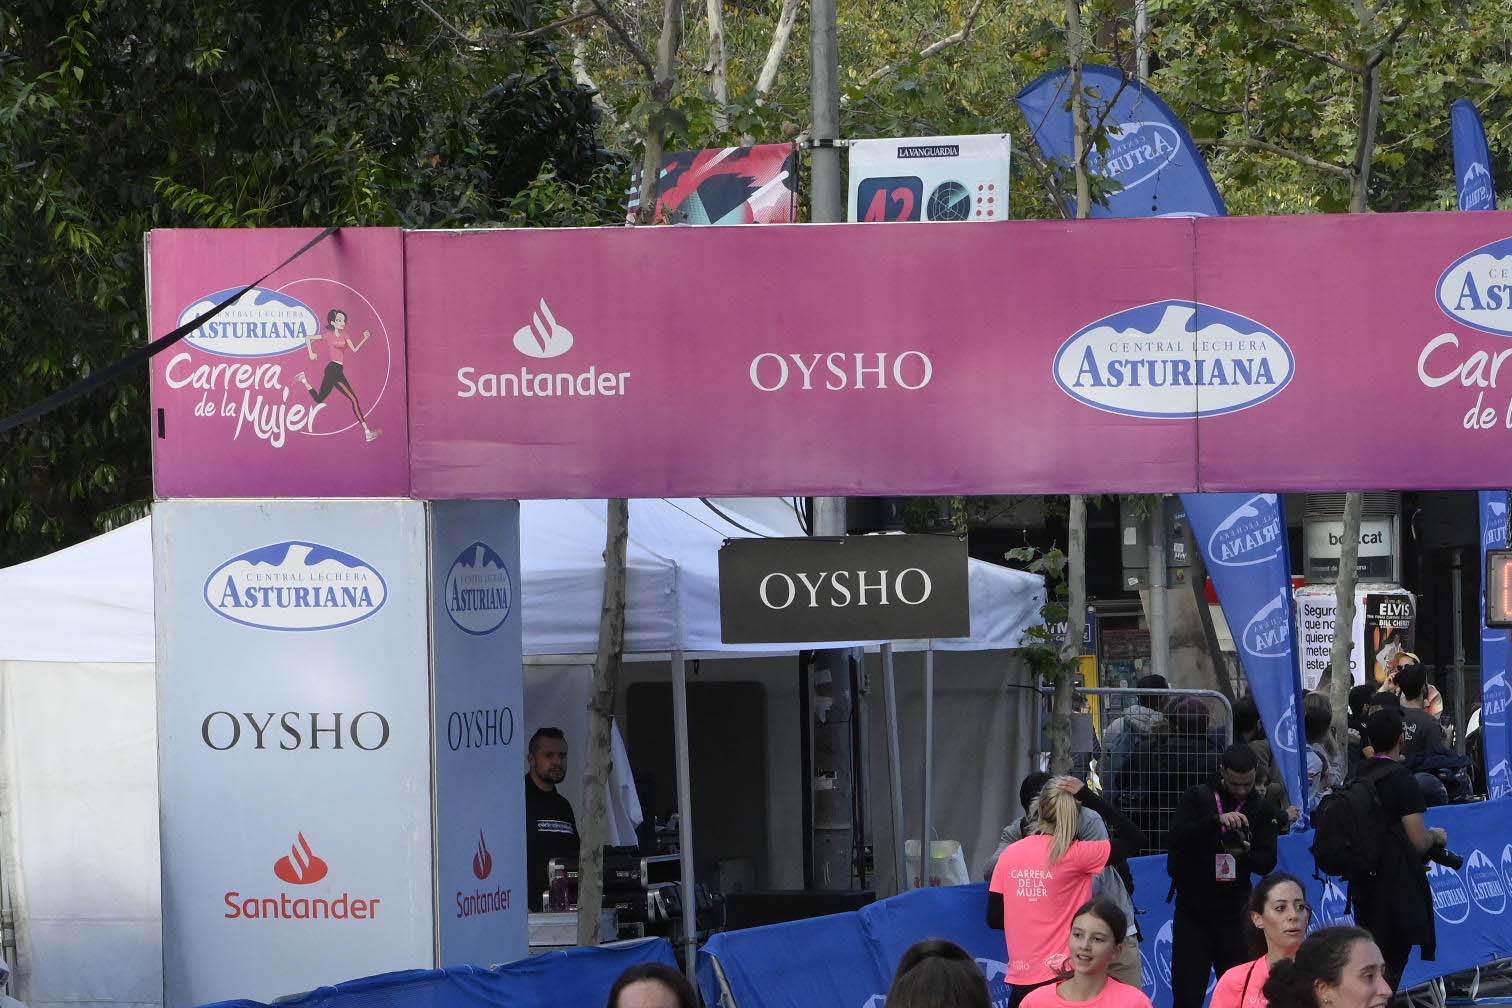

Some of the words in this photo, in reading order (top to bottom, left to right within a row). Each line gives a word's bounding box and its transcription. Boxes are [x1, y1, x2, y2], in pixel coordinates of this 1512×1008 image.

[1109, 340, 1183, 353] CENTRAL
[1193, 340, 1267, 353] LECHERA
[165, 352, 282, 390] Carrera
[457, 366, 630, 398] Santander
[749, 350, 933, 392] OYSHO
[1073, 344, 1275, 388] ASTURIANA
[195, 392, 216, 417] de
[221, 391, 236, 417] la
[234, 386, 327, 448] Mujer
[1463, 391, 1498, 429] de
[219, 574, 374, 609] ASTURIANA
[246, 572, 301, 582] CENTRAL
[310, 572, 367, 582] LECHERA
[759, 567, 932, 610] OYSHO
[451, 579, 508, 613] ASTURIANA
[1379, 603, 1410, 616] ELVIS
[1305, 620, 1321, 631] que
[1305, 632, 1334, 645] quiere
[1306, 660, 1325, 670] este
[201, 711, 390, 751] OYSHO
[448, 706, 513, 751] OYSHO
[1011, 869, 1053, 880] CARRERA
[1018, 879, 1031, 888] DE
[1033, 879, 1045, 888] LA
[224, 890, 380, 919] Santander
[456, 886, 512, 919] Santander
[1016, 887, 1048, 897] MUJER
